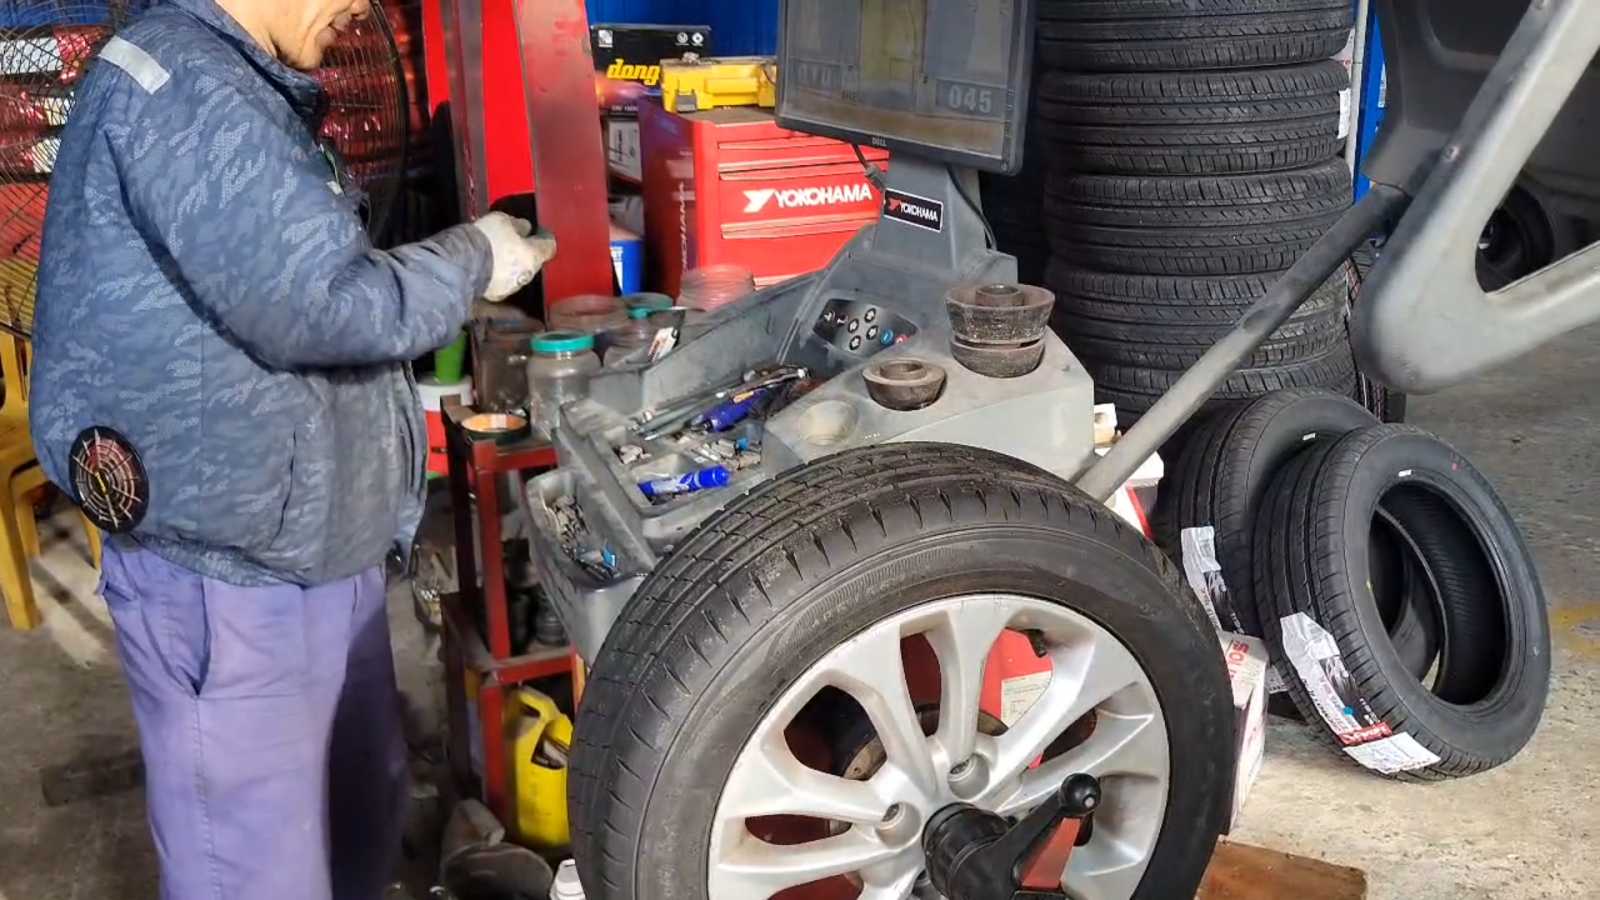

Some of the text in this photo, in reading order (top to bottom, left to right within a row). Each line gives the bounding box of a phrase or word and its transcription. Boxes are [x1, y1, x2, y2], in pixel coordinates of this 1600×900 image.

[949, 84, 992, 113] 045
[871, 137, 887, 147] DELL
[775, 183, 872, 209] YOKOHAMA
[900, 202, 939, 222] YOKOHAMA
